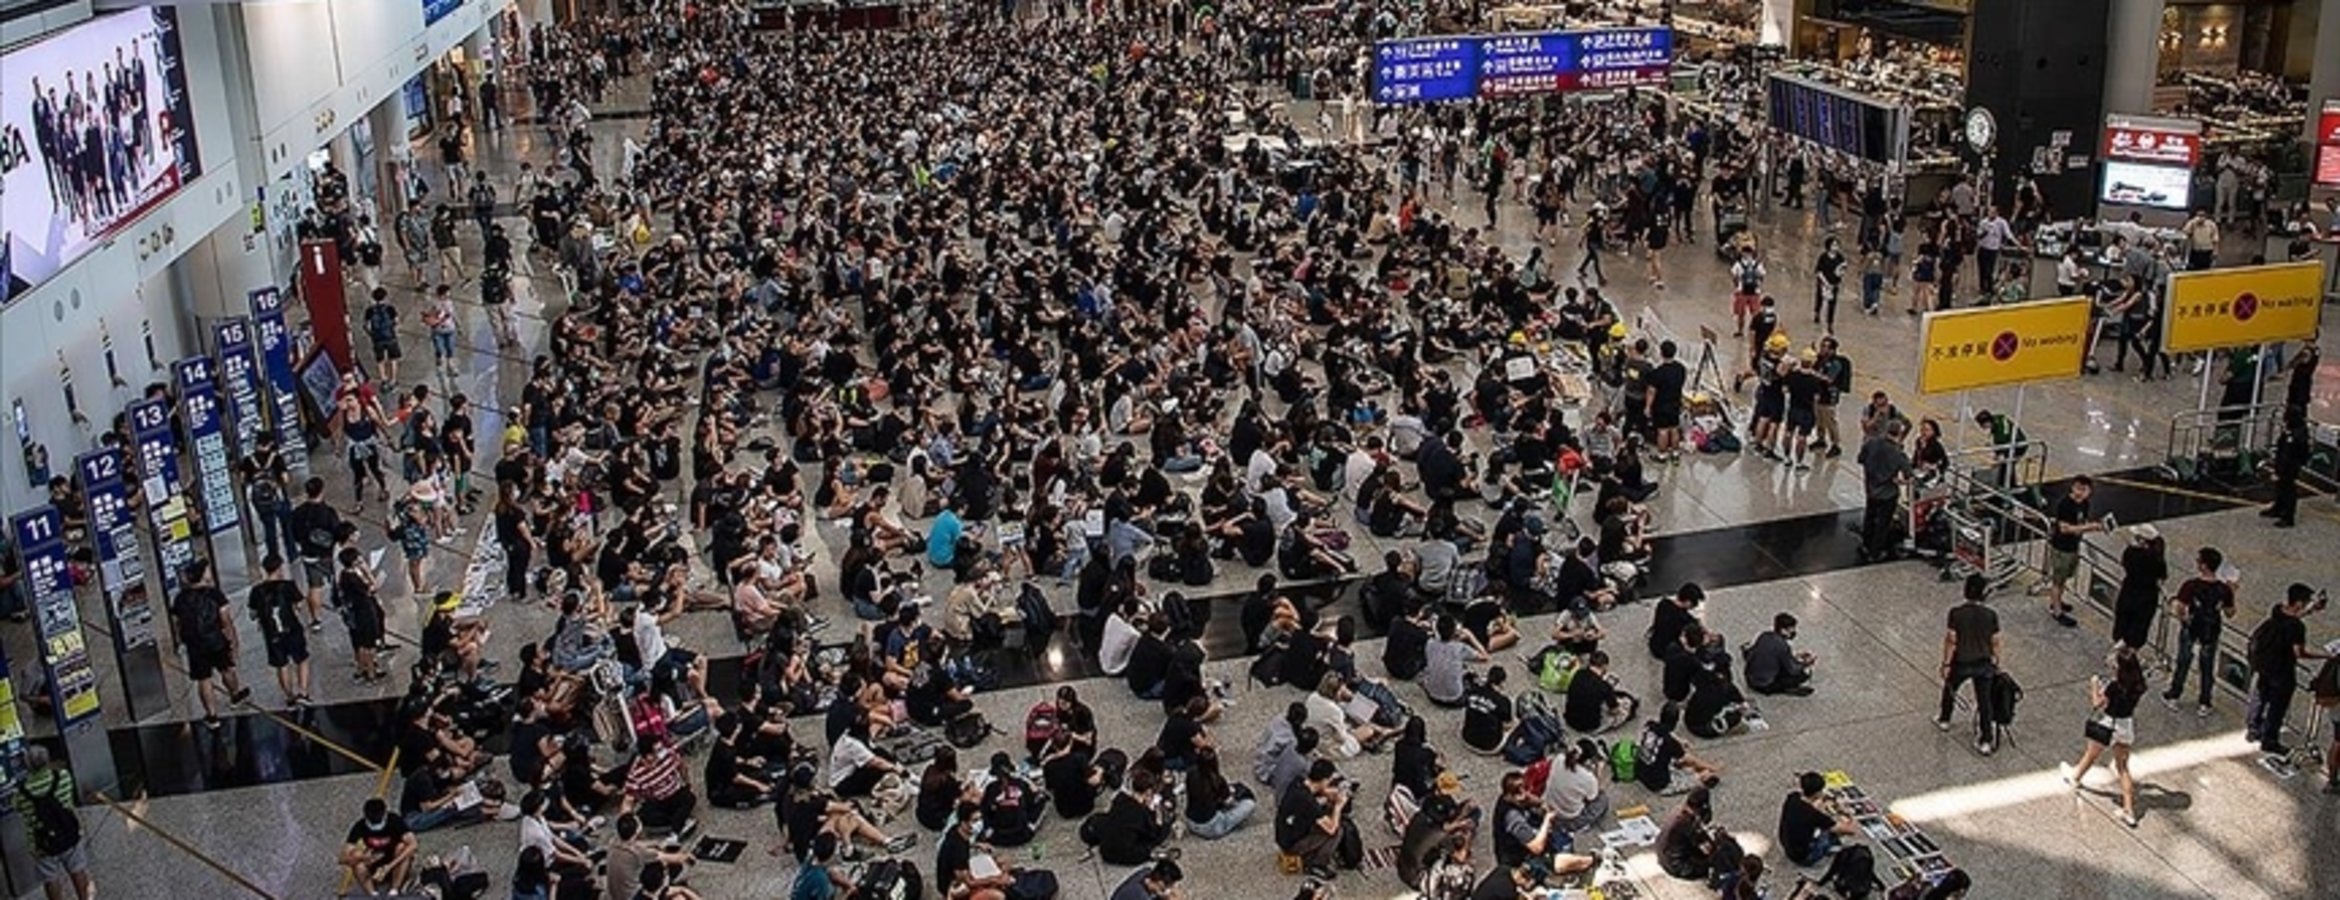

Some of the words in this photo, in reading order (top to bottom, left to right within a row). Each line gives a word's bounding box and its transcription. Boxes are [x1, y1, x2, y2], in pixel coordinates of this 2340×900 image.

[256, 292, 278, 310] 16
[2261, 298, 2276, 308] No
[2277, 295, 2314, 308] waiting
[221, 324, 245, 345] 15
[2022, 336, 2037, 348] No
[2039, 333, 2079, 346] waiting
[183, 362, 207, 383] 14
[135, 405, 163, 428] 13
[86, 455, 117, 481] 12
[26, 515, 53, 541] 11
